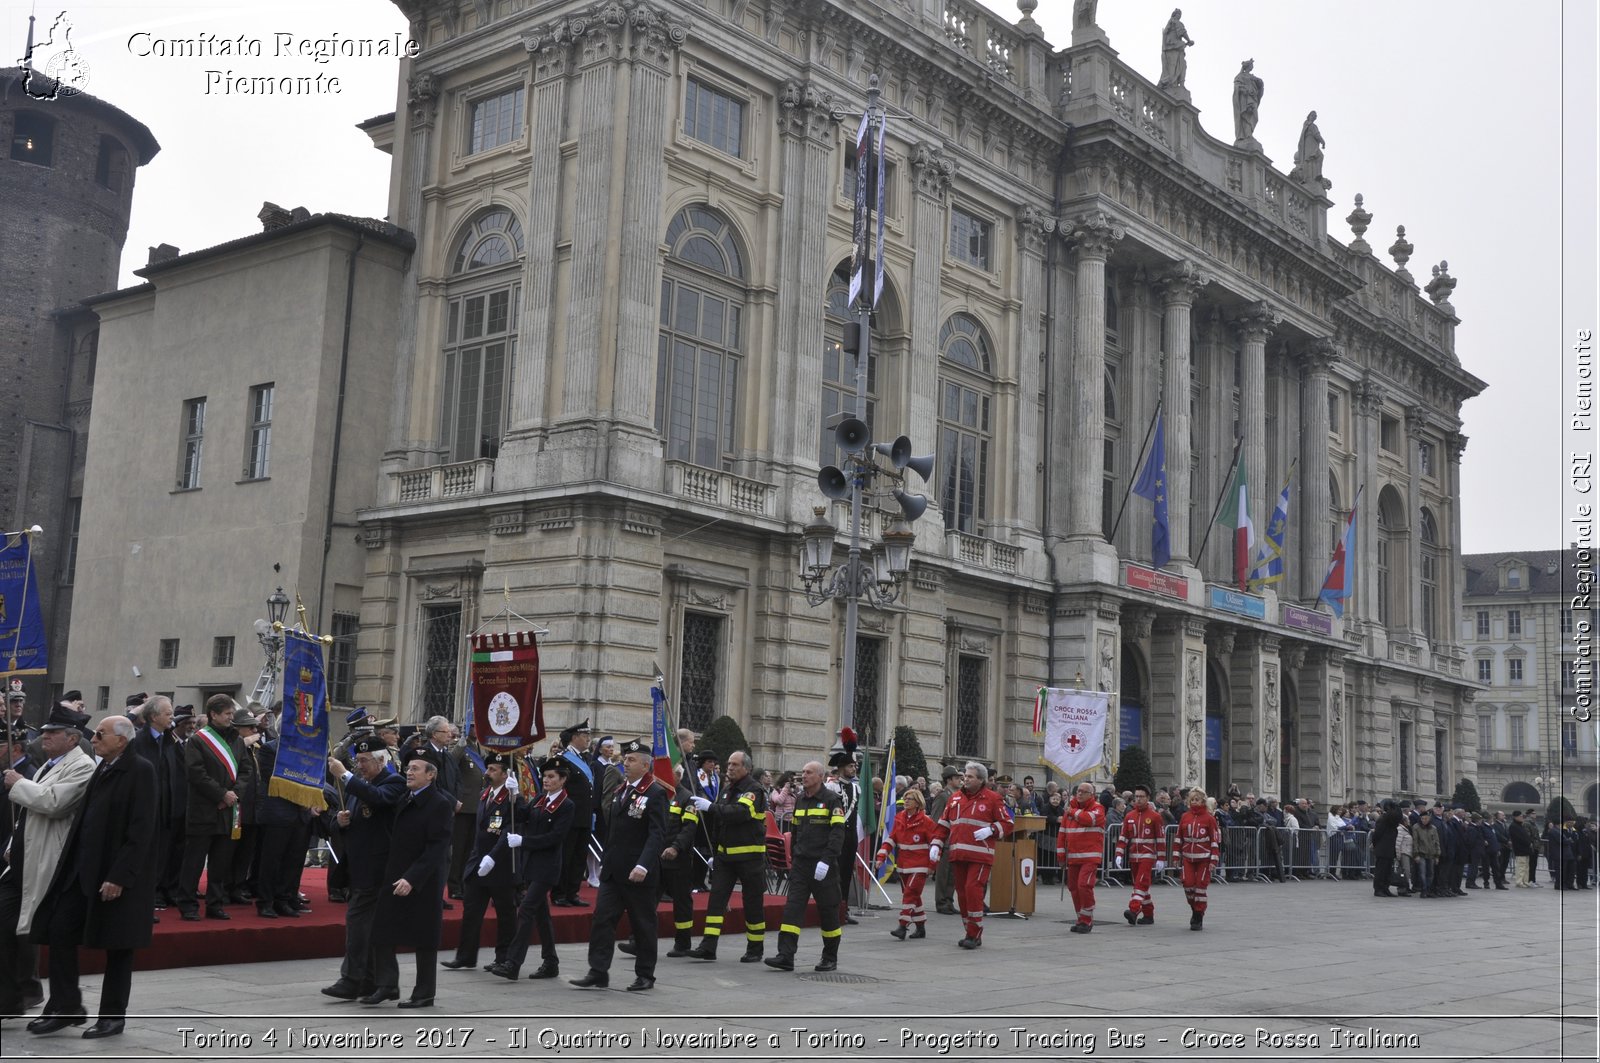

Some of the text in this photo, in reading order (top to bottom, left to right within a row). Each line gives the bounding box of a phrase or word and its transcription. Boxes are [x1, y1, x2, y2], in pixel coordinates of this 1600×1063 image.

[1054, 705, 1097, 716] CROCE ROSSA
[1062, 713, 1089, 721] ITALIANA
